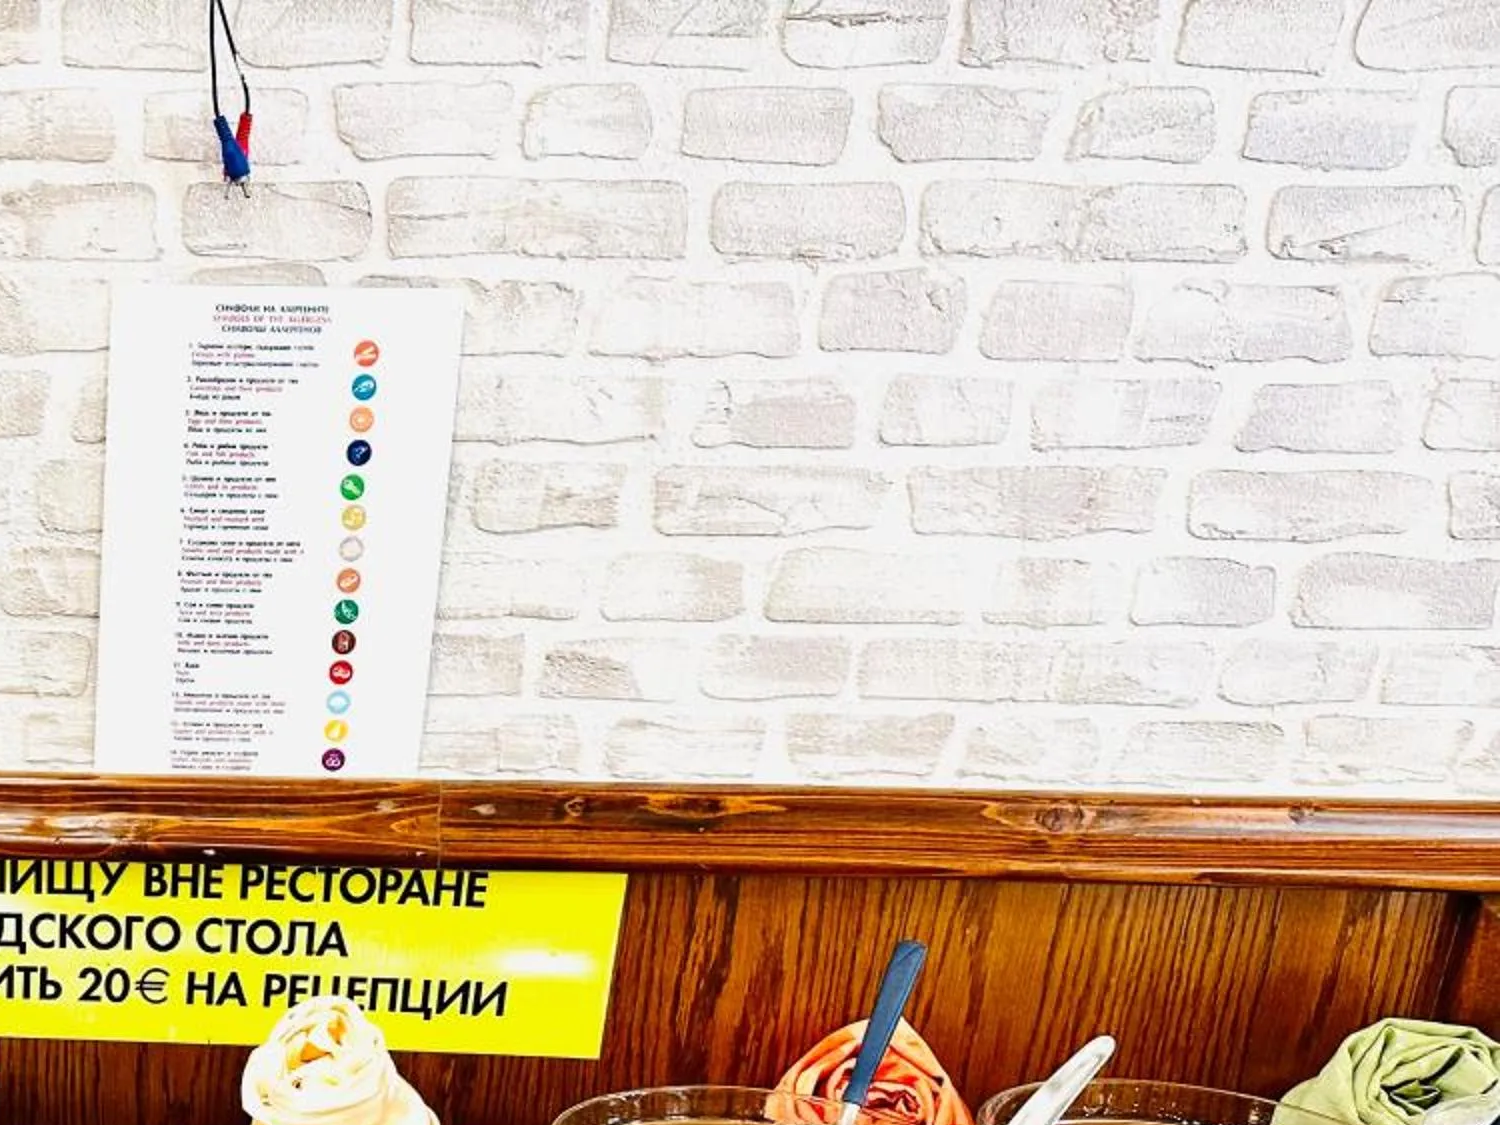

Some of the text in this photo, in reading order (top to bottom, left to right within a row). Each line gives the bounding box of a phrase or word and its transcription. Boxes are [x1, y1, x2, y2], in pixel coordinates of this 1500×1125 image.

[143, 863, 225, 899] ВНЕ
[239, 865, 489, 907] РЕСТОРАНЕ
[195, 917, 349, 957] СТОЛА
[77, 966, 171, 1004] 20€
[185, 970, 248, 1007] НА
